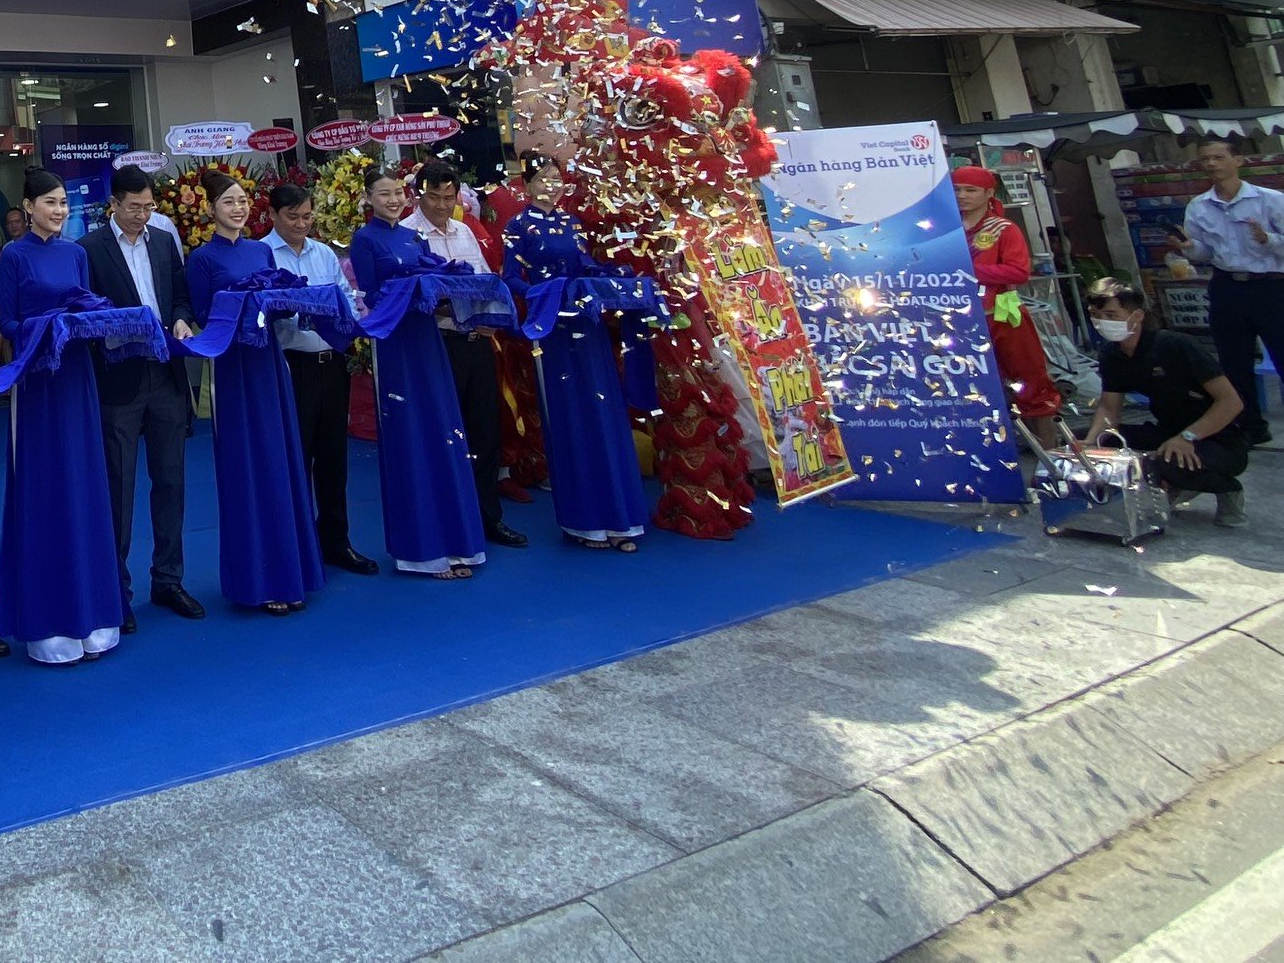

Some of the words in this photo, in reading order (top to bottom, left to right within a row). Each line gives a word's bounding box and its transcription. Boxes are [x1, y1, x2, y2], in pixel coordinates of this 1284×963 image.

[860, 141, 878, 149] Viet
[879, 140, 909, 150] Capital
[821, 157, 862, 174] hàng
[865, 154, 899, 169] Bản
[900, 153, 935, 169] Việt
[853, 271, 965, 290] 15/11/2022
[929, 293, 971, 306] ĐỘNG
